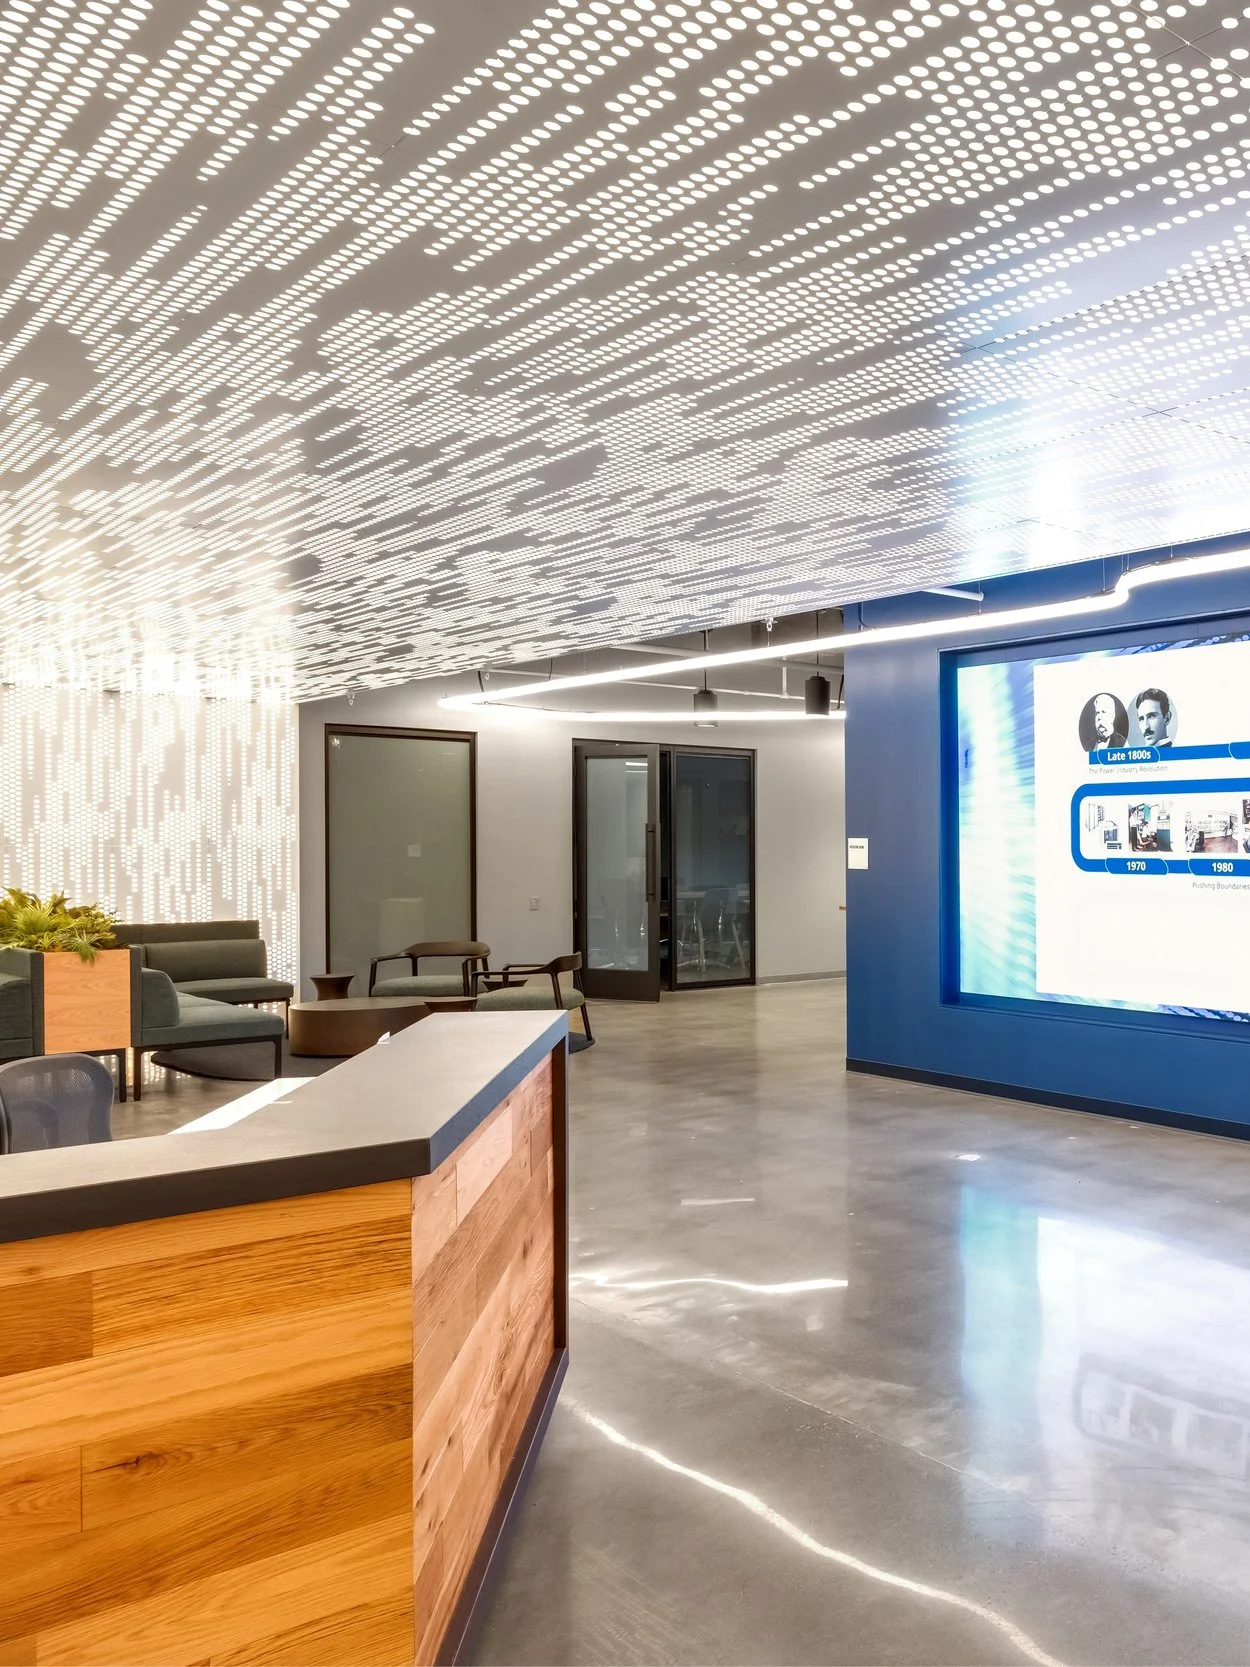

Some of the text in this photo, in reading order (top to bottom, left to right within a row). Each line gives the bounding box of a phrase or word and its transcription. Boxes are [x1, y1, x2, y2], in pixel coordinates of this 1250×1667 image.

[1107, 749, 1151, 761] Late 1800s
[1126, 861, 1146, 871] 1970
[1211, 862, 1234, 873] 1980
[1192, 882, 1215, 890] Pushing
[1216, 882, 1250, 890] Boundaries
